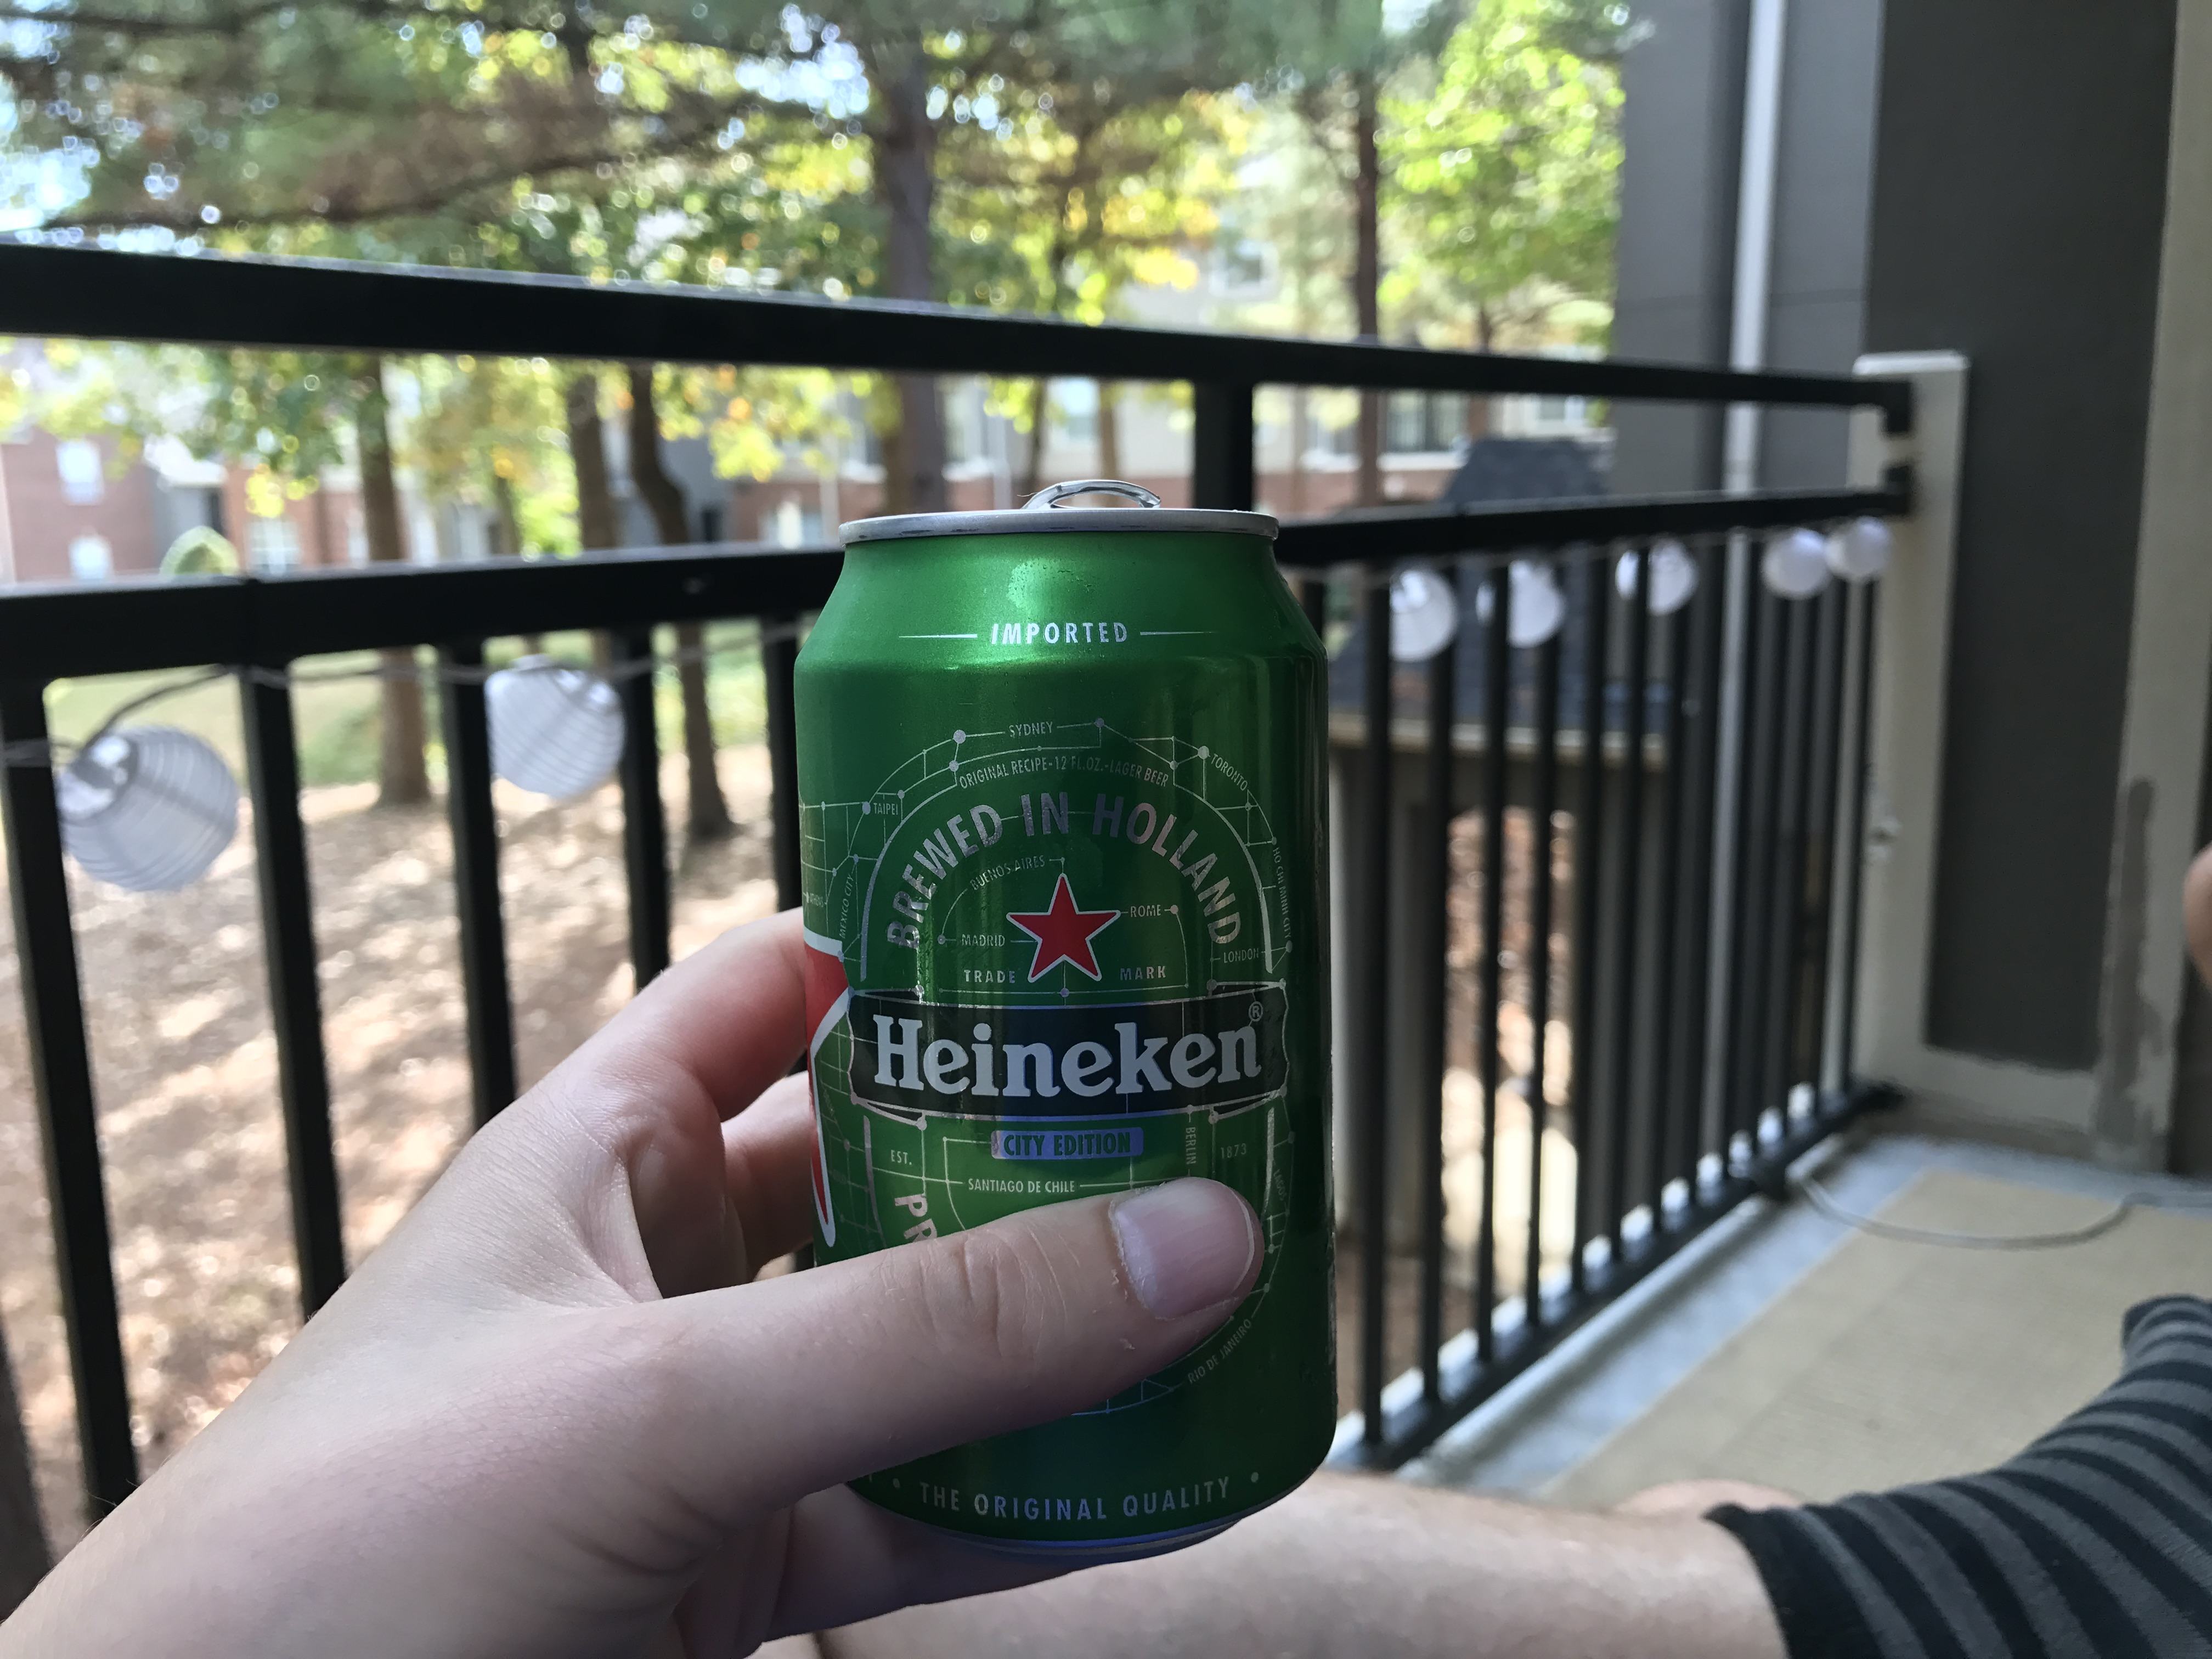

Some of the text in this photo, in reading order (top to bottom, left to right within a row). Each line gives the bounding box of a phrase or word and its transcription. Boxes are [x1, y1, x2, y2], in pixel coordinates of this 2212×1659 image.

[991, 622, 1128, 645] IMPORTED
[1008, 721, 1053, 738] SYDNEY
[960, 764, 1008, 788] ORIGINAL
[1144, 768, 1169, 787] BEER
[1210, 753, 1249, 791] TORONTO
[873, 802, 899, 815] TAIPEI
[1014, 855, 1046, 871] AIRES
[1272, 847, 1282, 864] HO
[887, 792, 1241, 949] BREWED IN HOLLAND
[1276, 866, 1285, 884] CHI
[838, 873, 855, 939] MEXICO CITY
[1130, 904, 1161, 917] ROME
[1279, 885, 1290, 916] MINH
[961, 933, 1005, 947] MADRID
[1223, 948, 1259, 964] LONDON
[964, 966, 1167, 983] TRADE MARK
[873, 1014, 1262, 1098] Heineken
[1003, 1131, 1131, 1156] CITY EDITION
[1186, 1126, 1197, 1165] BERLIN
[1220, 1143, 1247, 1159] 1873
[890, 1149, 912, 1165] EST.
[968, 1178, 1075, 1193] SANTIAGO DE CHILE
[1273, 1168, 1287, 1201] LAGOS
[1187, 1318, 1252, 1384] RIO DE JANEIRO
[919, 1476, 1231, 1521] THE ORIGINAL QUALITY
